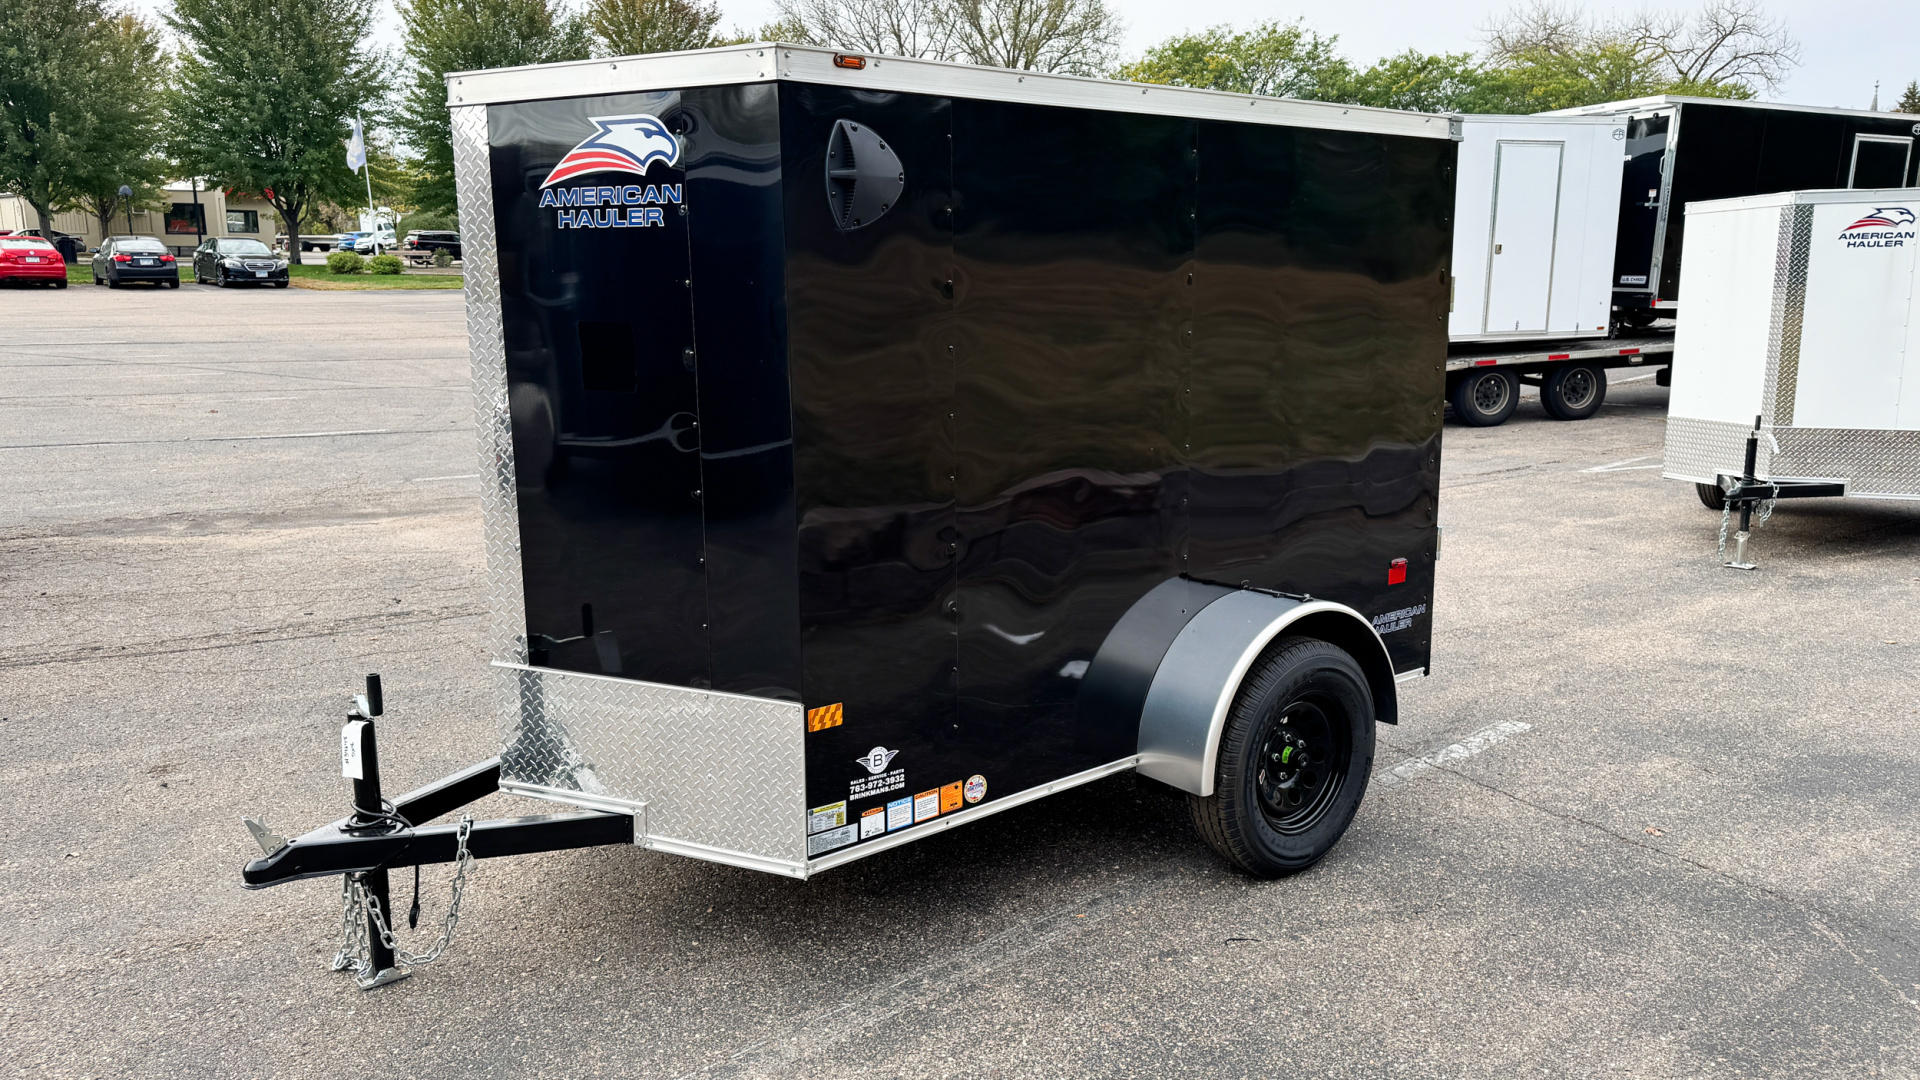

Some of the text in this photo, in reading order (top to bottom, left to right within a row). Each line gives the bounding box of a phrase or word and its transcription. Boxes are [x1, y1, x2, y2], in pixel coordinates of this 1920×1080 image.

[538, 183, 683, 208] AMERICAN
[557, 207, 665, 229] HAULER
[1837, 231, 1915, 241] AMERICAN
[1846, 240, 1904, 248] HAULER
[1372, 604, 1426, 626] AMERICAN
[849, 786, 905, 801] BRINKMANS.COM
[914, 788, 938, 800] CAUTION
[888, 797, 912, 809] NOTICE
